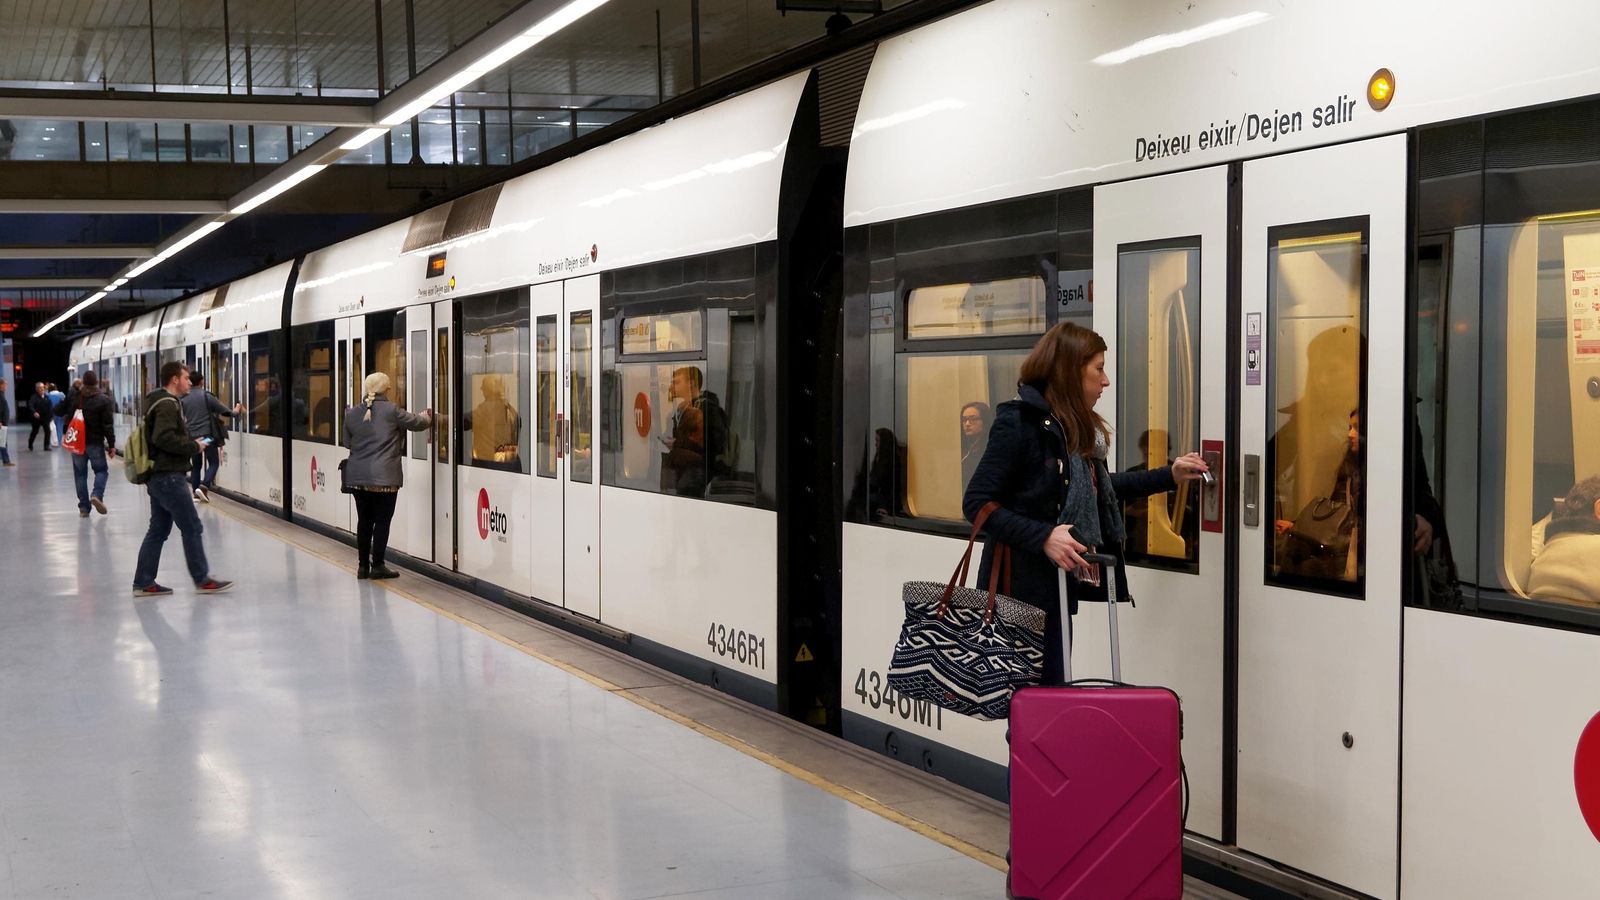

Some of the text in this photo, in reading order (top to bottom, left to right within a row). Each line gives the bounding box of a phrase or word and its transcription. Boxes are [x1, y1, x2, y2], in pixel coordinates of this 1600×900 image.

[1136, 134, 1190, 162] Deixeu
[1312, 95, 1357, 128] salir
[481, 506, 507, 535] metro
[707, 622, 766, 670] 4346R1
